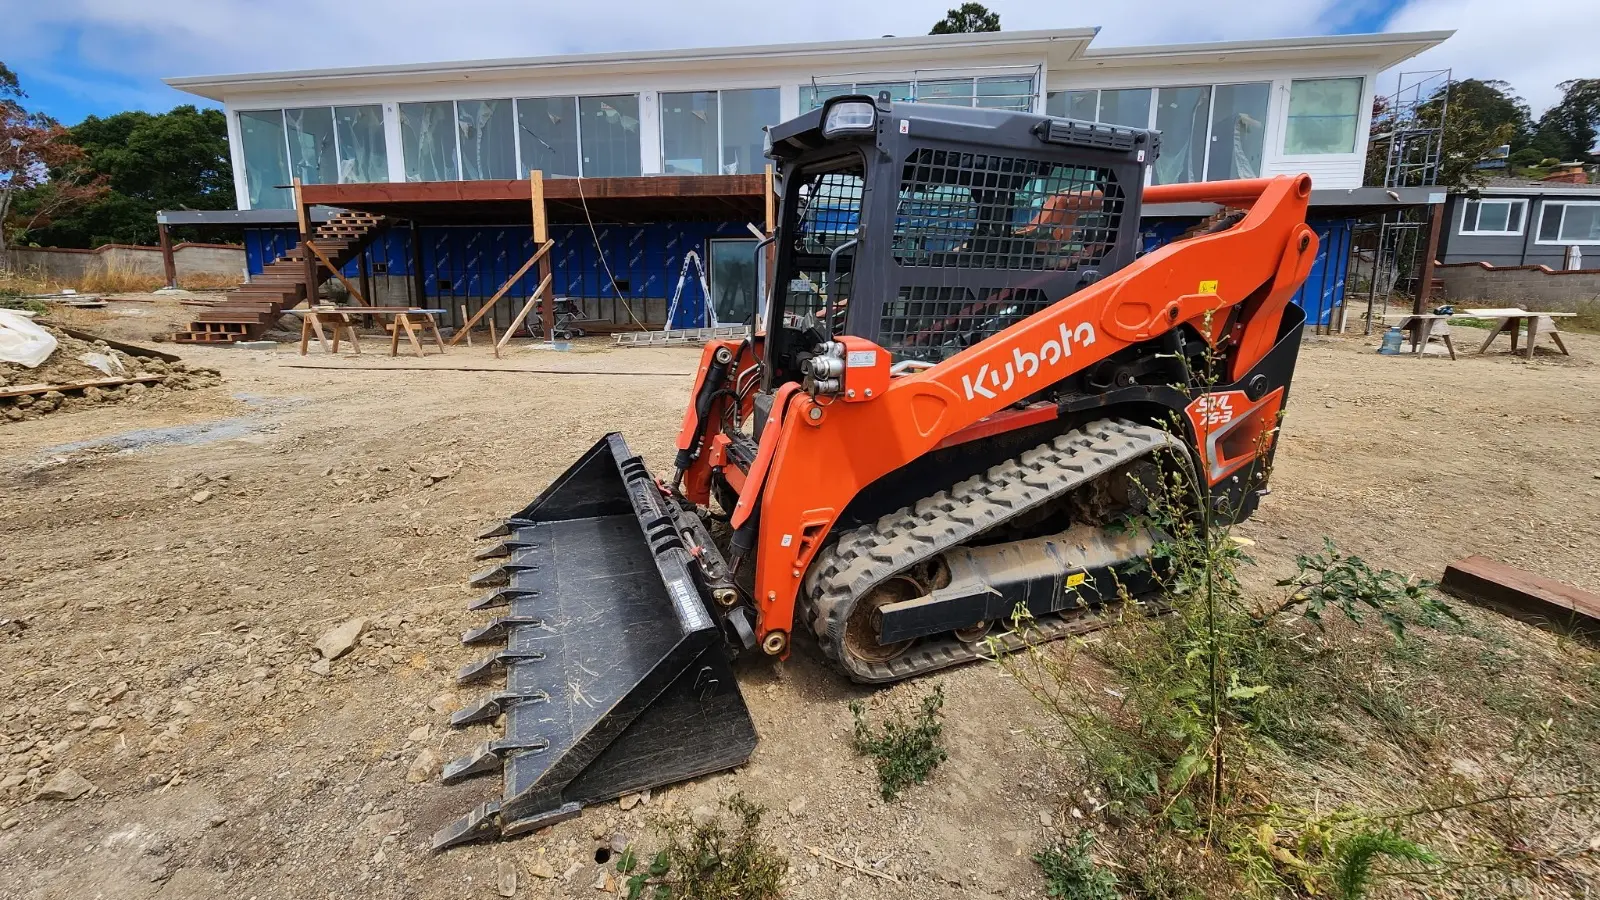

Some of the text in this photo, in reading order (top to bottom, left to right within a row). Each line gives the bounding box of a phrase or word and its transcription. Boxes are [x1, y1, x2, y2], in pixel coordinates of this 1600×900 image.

[961, 321, 1096, 401] Kubota
[1199, 410, 1233, 425] 75-3
[672, 579, 702, 628] BLUE DIAMOND
